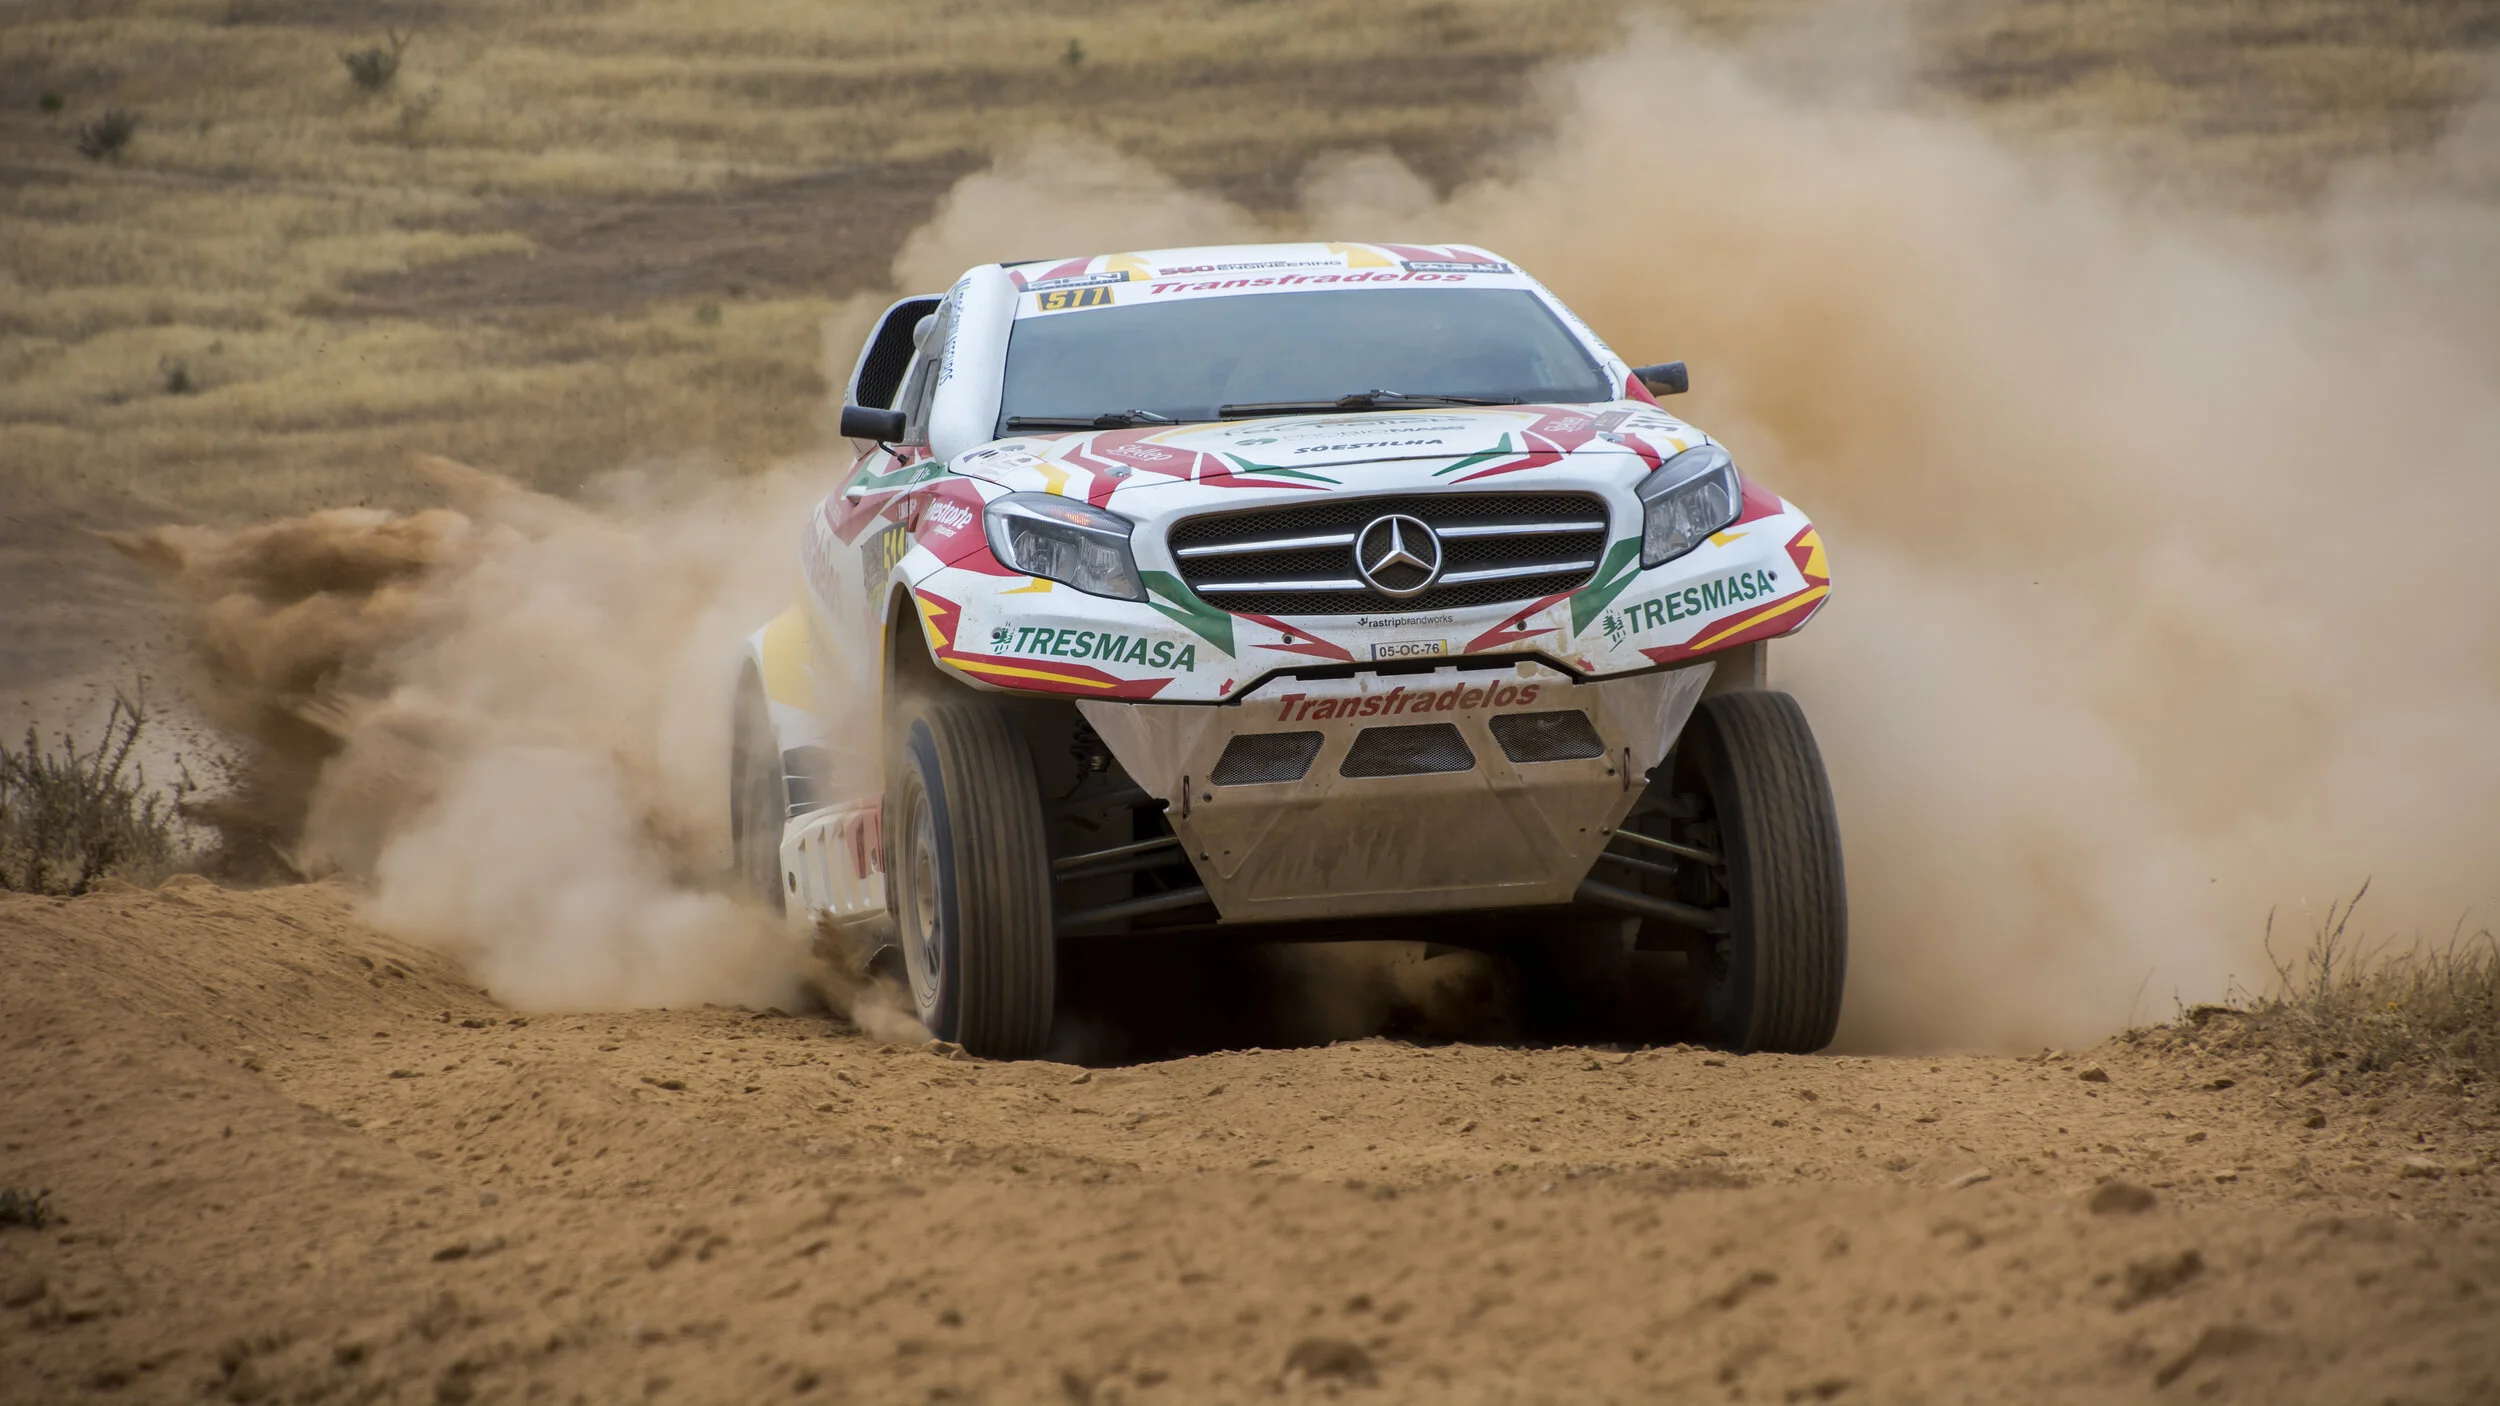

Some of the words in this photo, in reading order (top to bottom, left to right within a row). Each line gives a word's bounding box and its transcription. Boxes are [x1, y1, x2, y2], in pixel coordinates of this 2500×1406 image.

[1151, 271, 1468, 294] Transfradelos
[1624, 569, 1776, 634] TRESMASA
[1368, 614, 1454, 628] rastripbrandworks
[1013, 627, 1196, 672] TRESMASA
[1379, 643, 1440, 658] 05-OC-76
[1278, 679, 1541, 722] Transfradelos
